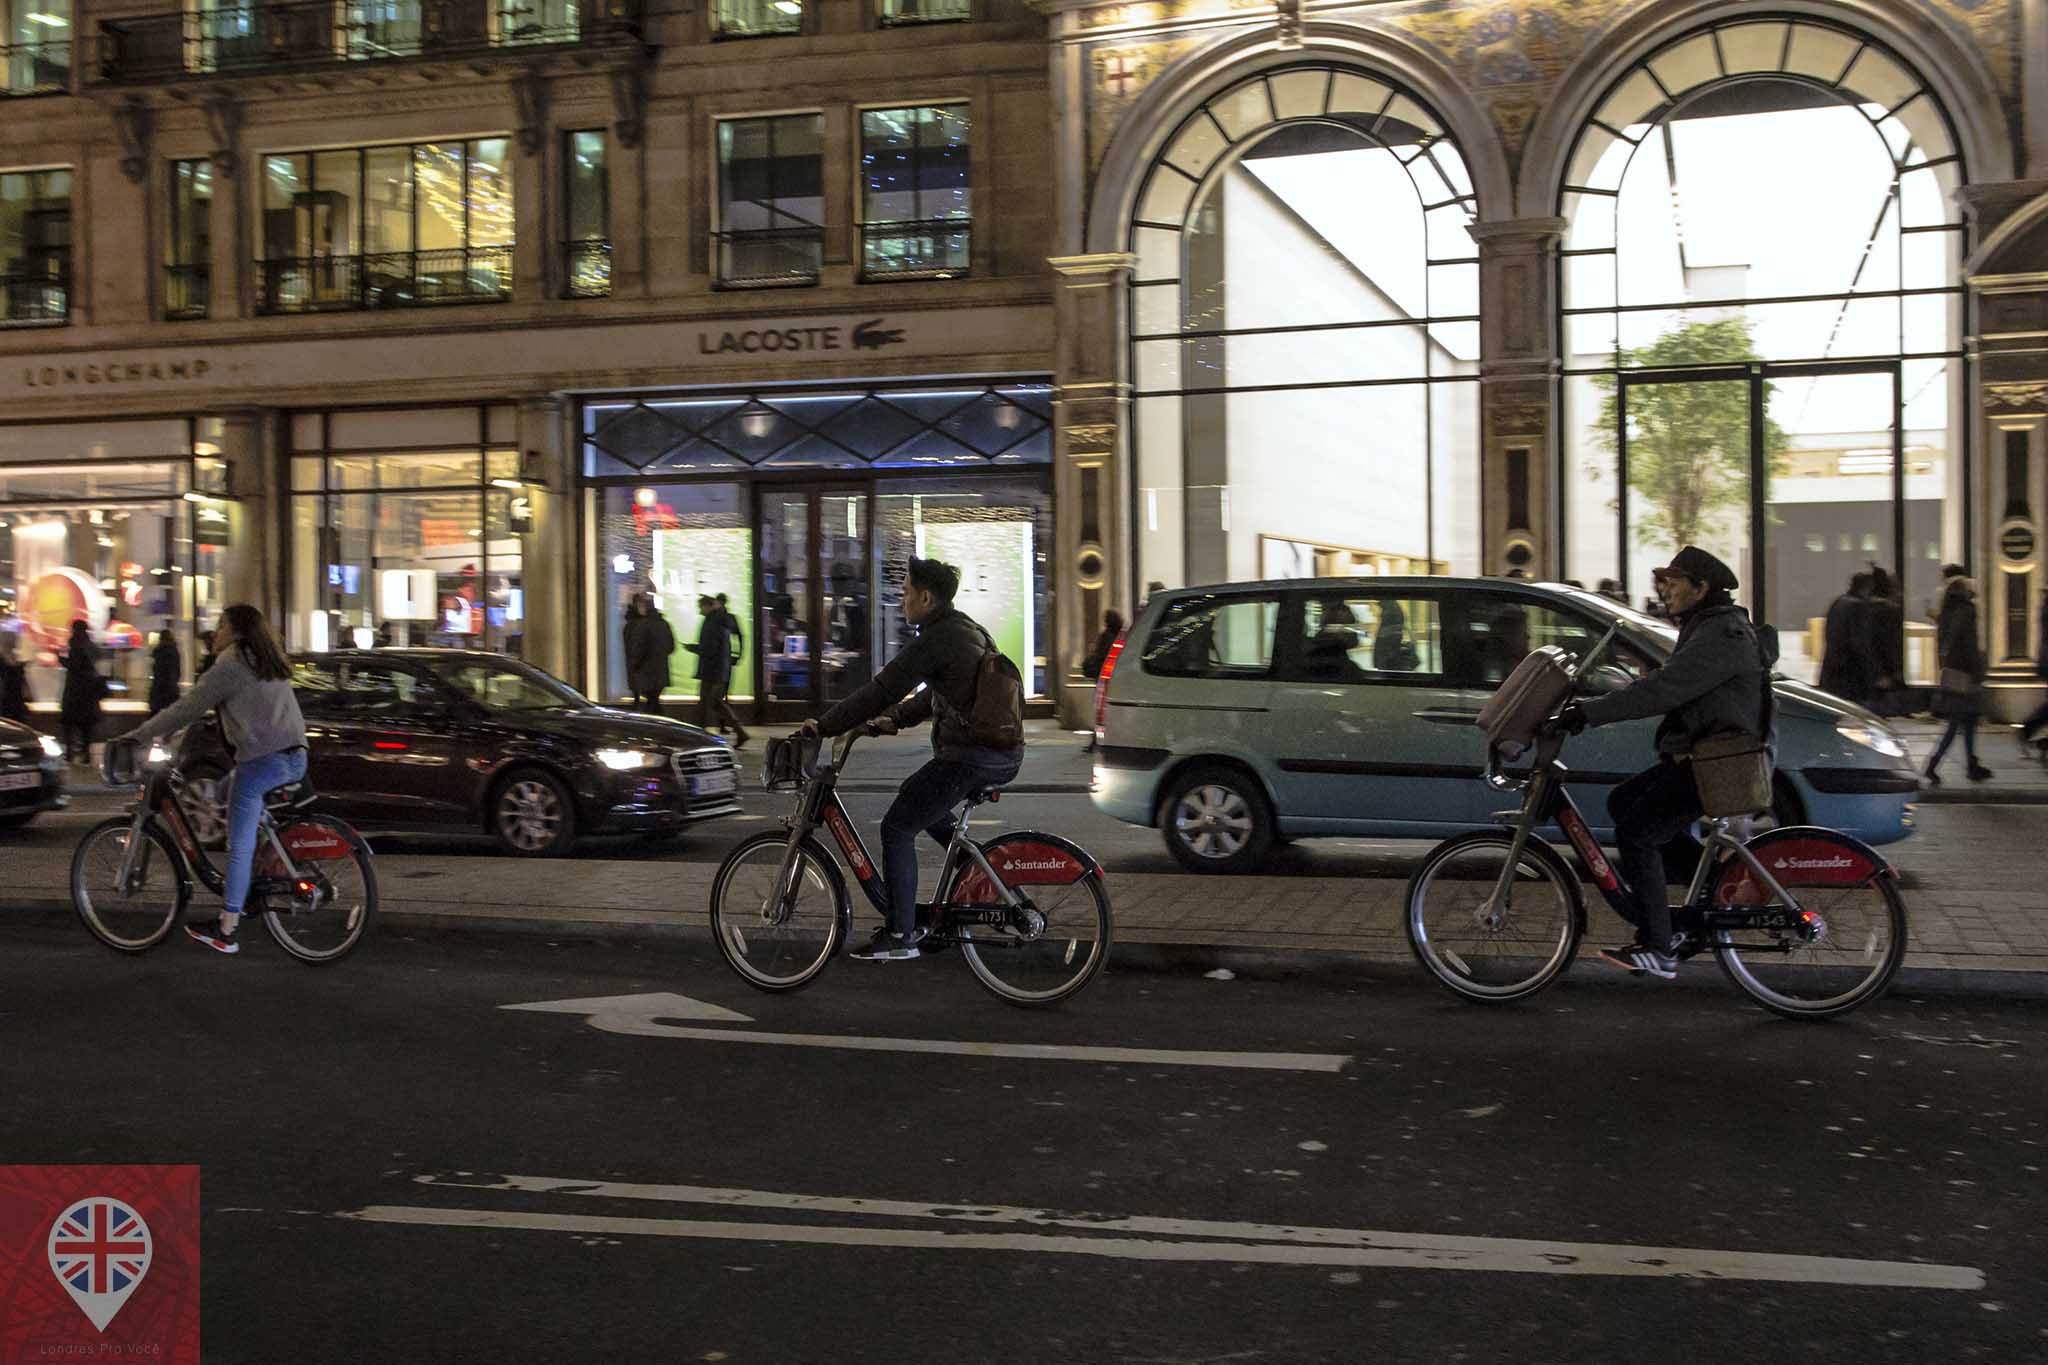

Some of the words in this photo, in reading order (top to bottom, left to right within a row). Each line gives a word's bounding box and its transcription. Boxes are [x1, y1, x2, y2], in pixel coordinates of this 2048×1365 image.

[698, 326, 842, 355] LACOSTE
[24, 359, 209, 388] LONGCHAMP
[1014, 857, 1067, 871] Santander
[1788, 855, 1853, 869] Santander
